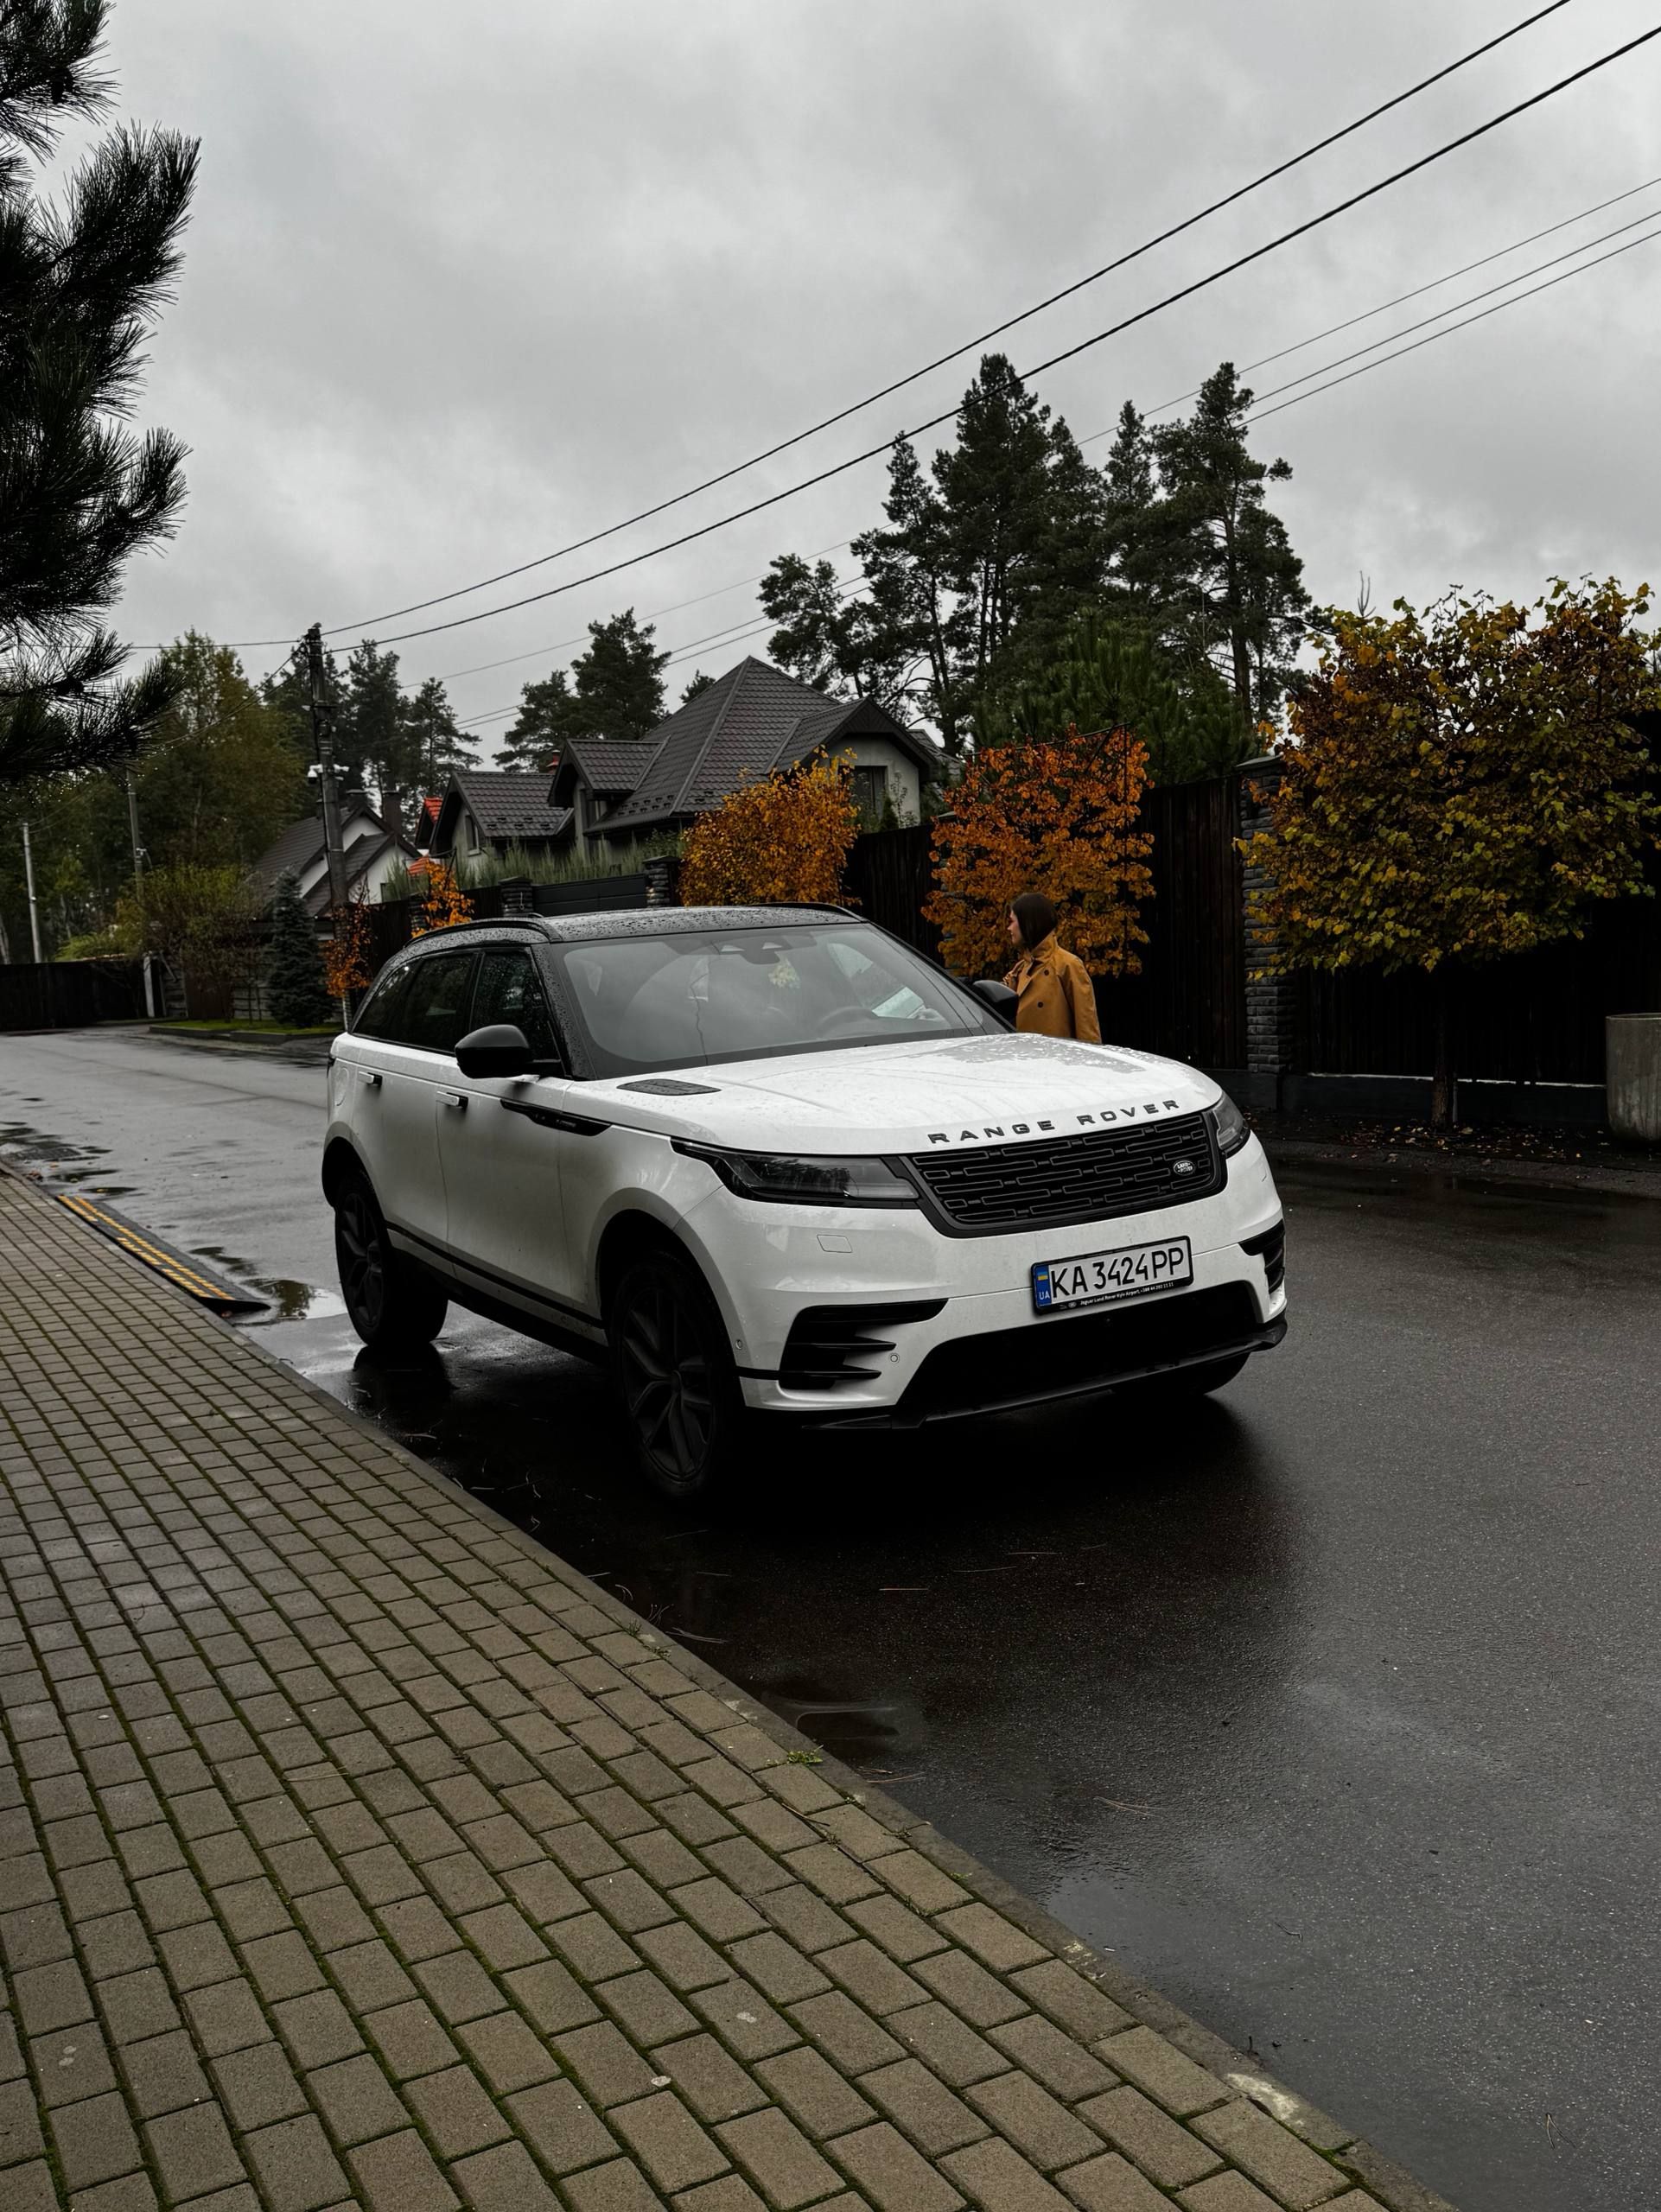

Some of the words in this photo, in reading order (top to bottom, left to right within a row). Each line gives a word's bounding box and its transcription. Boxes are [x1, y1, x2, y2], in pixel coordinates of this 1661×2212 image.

[927, 1120, 1056, 1145] RANGE
[1077, 1099, 1181, 1126] ROVER
[1039, 1291, 1051, 1300] UA
[1051, 1265, 1088, 1298] KA
[1092, 1253, 1149, 1290] 3424
[1151, 1247, 1184, 1279] PP
